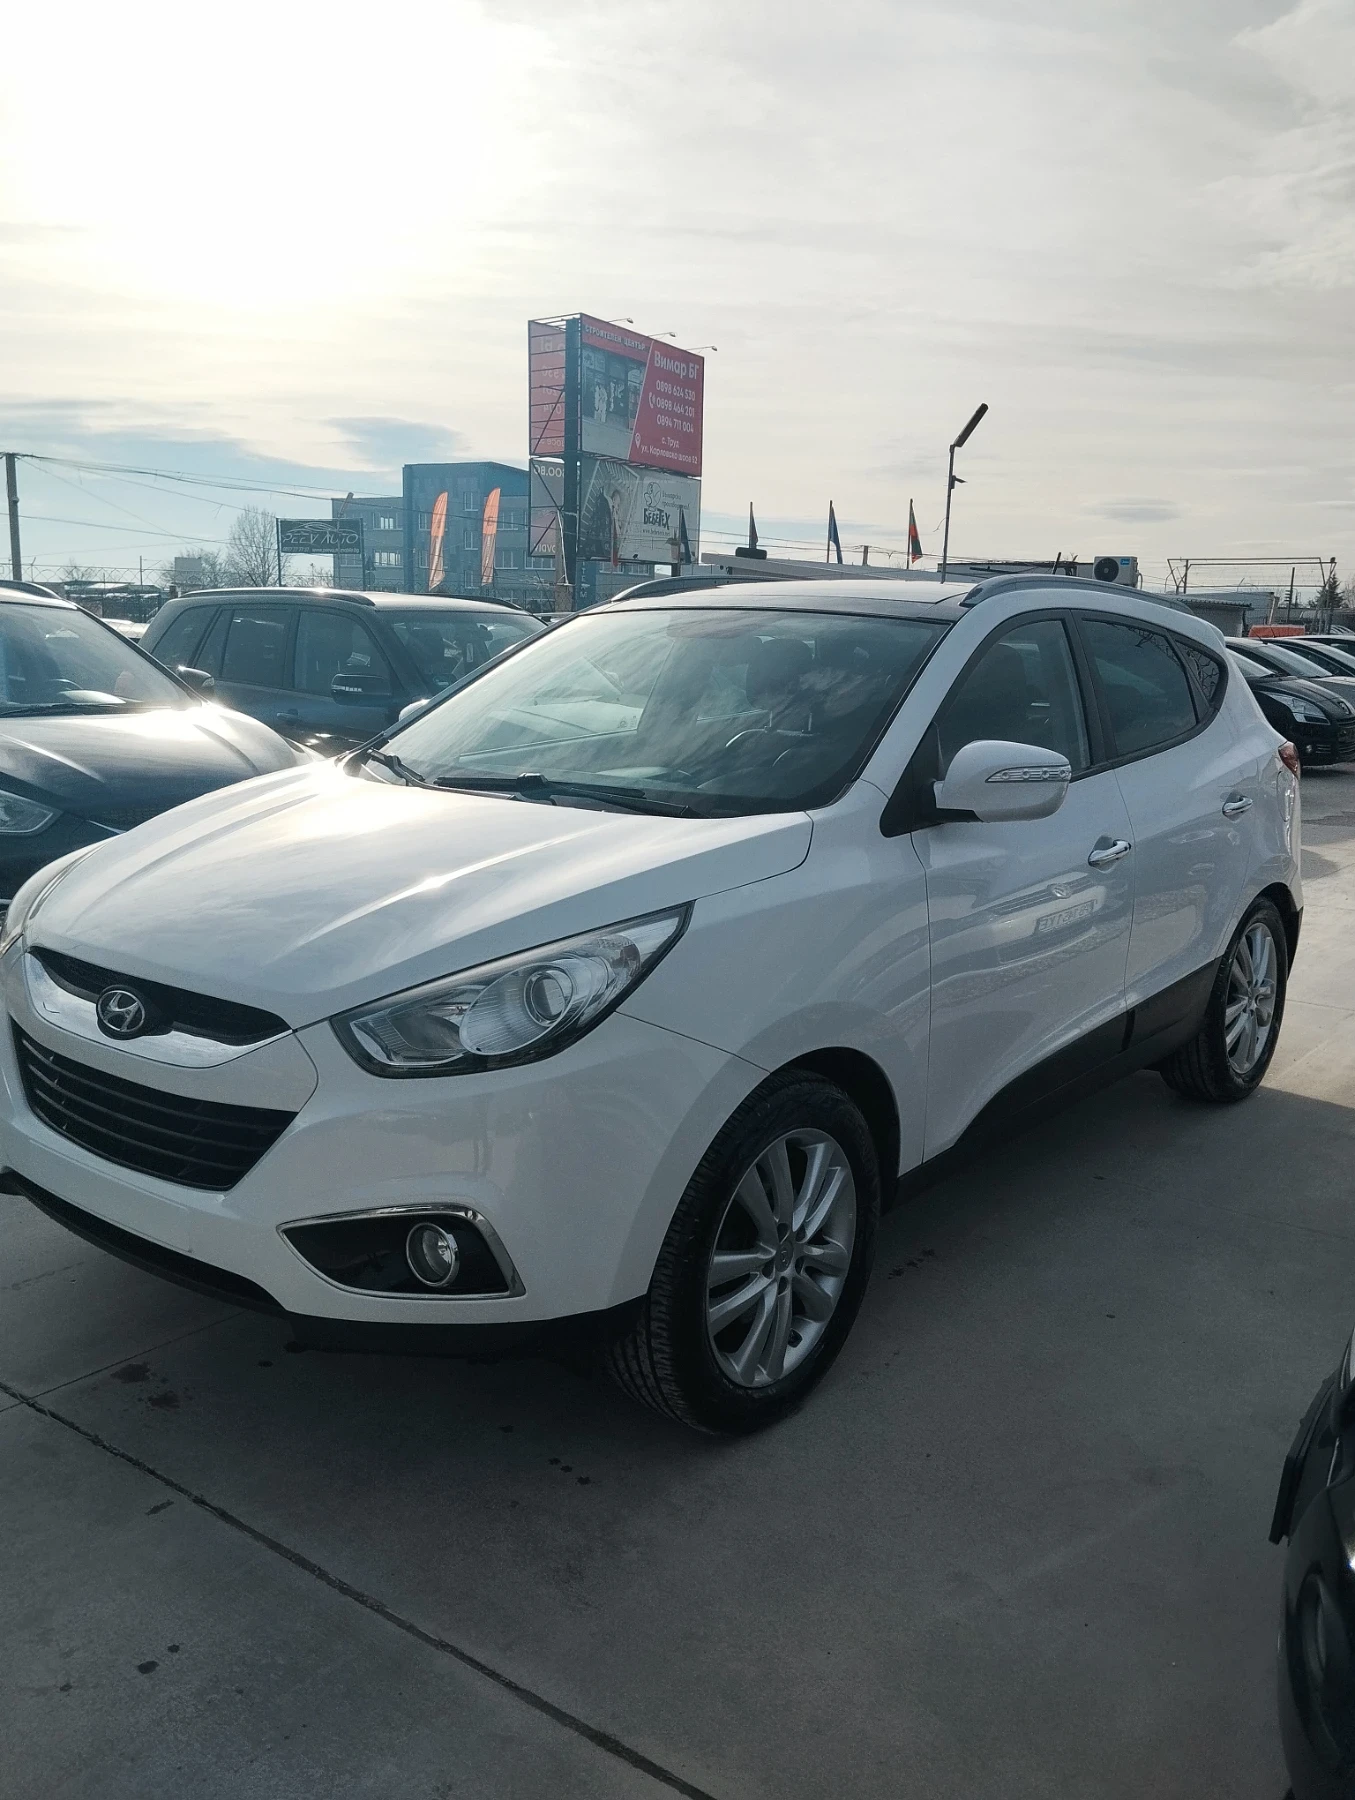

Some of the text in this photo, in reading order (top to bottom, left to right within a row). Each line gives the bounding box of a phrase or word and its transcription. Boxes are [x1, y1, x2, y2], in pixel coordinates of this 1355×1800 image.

[585, 325, 646, 350] СТРОИТЕЛЕН ЦЕНТЪР
[654, 350, 700, 379] Вимар БГ
[656, 380, 696, 401] 0898 624 530
[656, 397, 695, 417] 0898 464 201
[656, 414, 694, 433] 0894 711 004
[667, 436, 680, 448] Труд
[282, 532, 319, 544] PEEV
